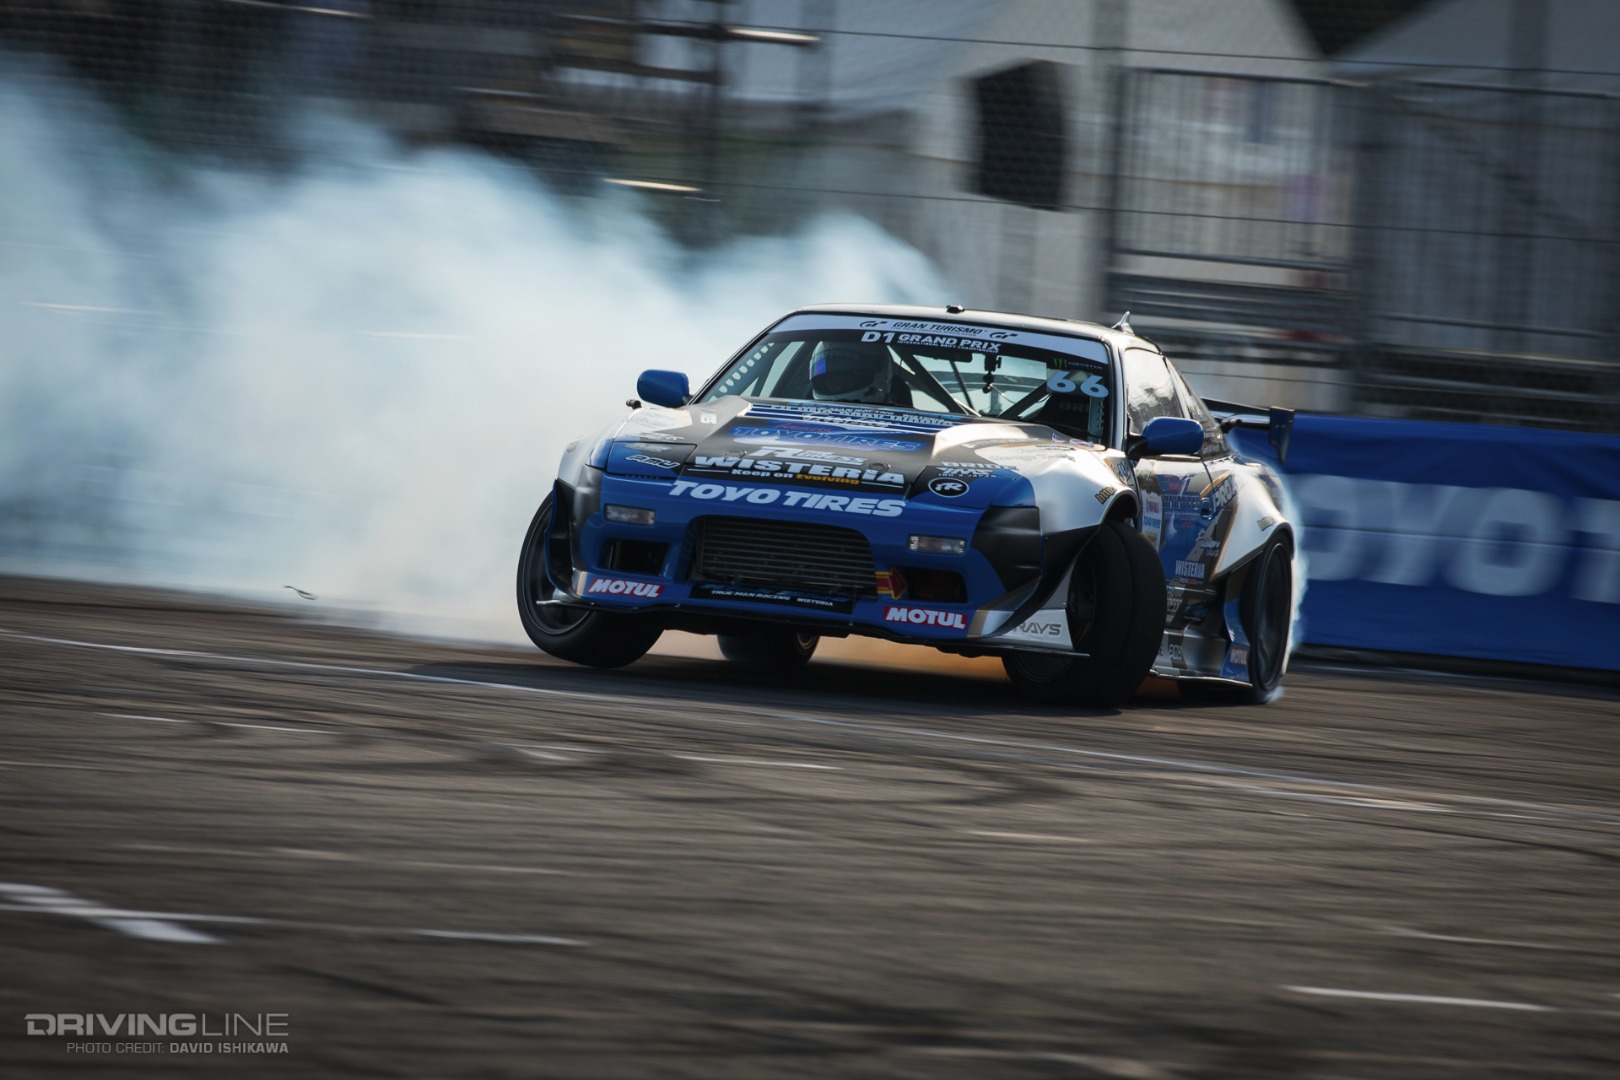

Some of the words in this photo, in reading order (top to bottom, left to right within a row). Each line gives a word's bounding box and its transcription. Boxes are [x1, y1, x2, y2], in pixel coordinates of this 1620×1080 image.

[892, 322, 928, 330] GRAN
[930, 324, 983, 335] TURISMO
[860, 331, 895, 344] D1
[898, 333, 958, 346] GRAND
[960, 339, 1002, 352] PRIX
[1046, 370, 1109, 398] 66
[695, 456, 904, 484] WISTERIA
[731, 469, 772, 478] Keep
[795, 474, 860, 485] Evolving
[668, 480, 780, 504] TOYO
[782, 490, 906, 518] TIRES
[1175, 560, 1205, 579] WISTERIA
[588, 579, 661, 598] MOTUL
[796, 596, 834, 607] WISTERIA
[886, 608, 967, 629] MOTUL
[1014, 622, 1062, 636] RAYS
